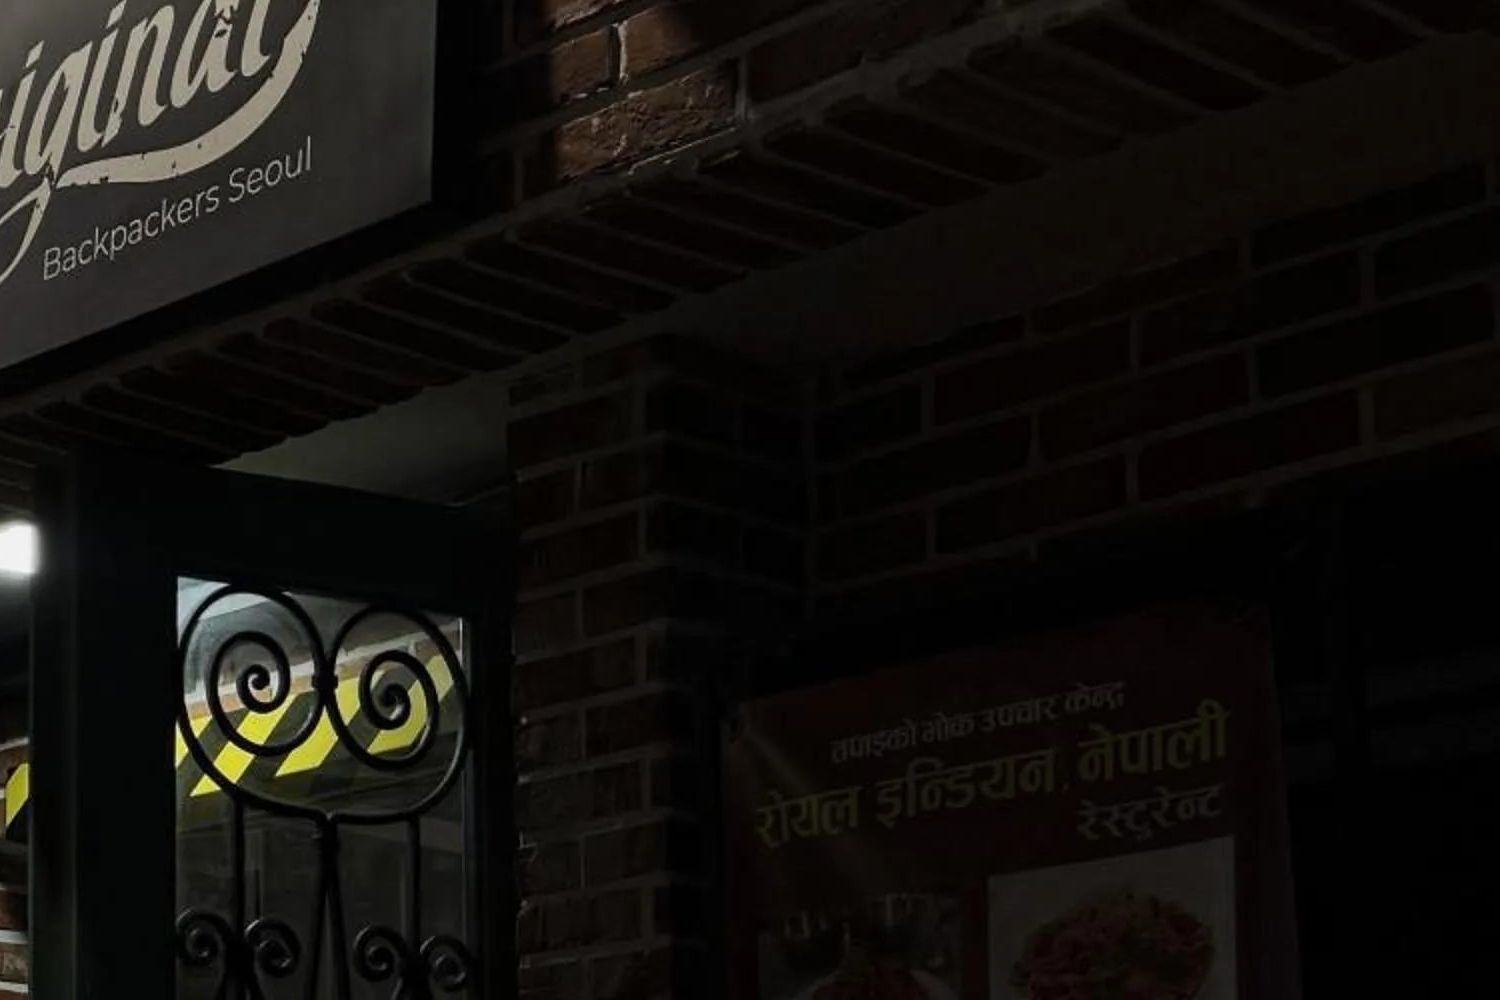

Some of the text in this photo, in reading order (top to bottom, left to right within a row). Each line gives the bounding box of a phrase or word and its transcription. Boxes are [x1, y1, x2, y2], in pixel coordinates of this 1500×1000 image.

[43, 136, 312, 281] Backpackers Seoul
[753, 783, 863, 848] रोयल
[1076, 697, 1232, 782] नेपाली
